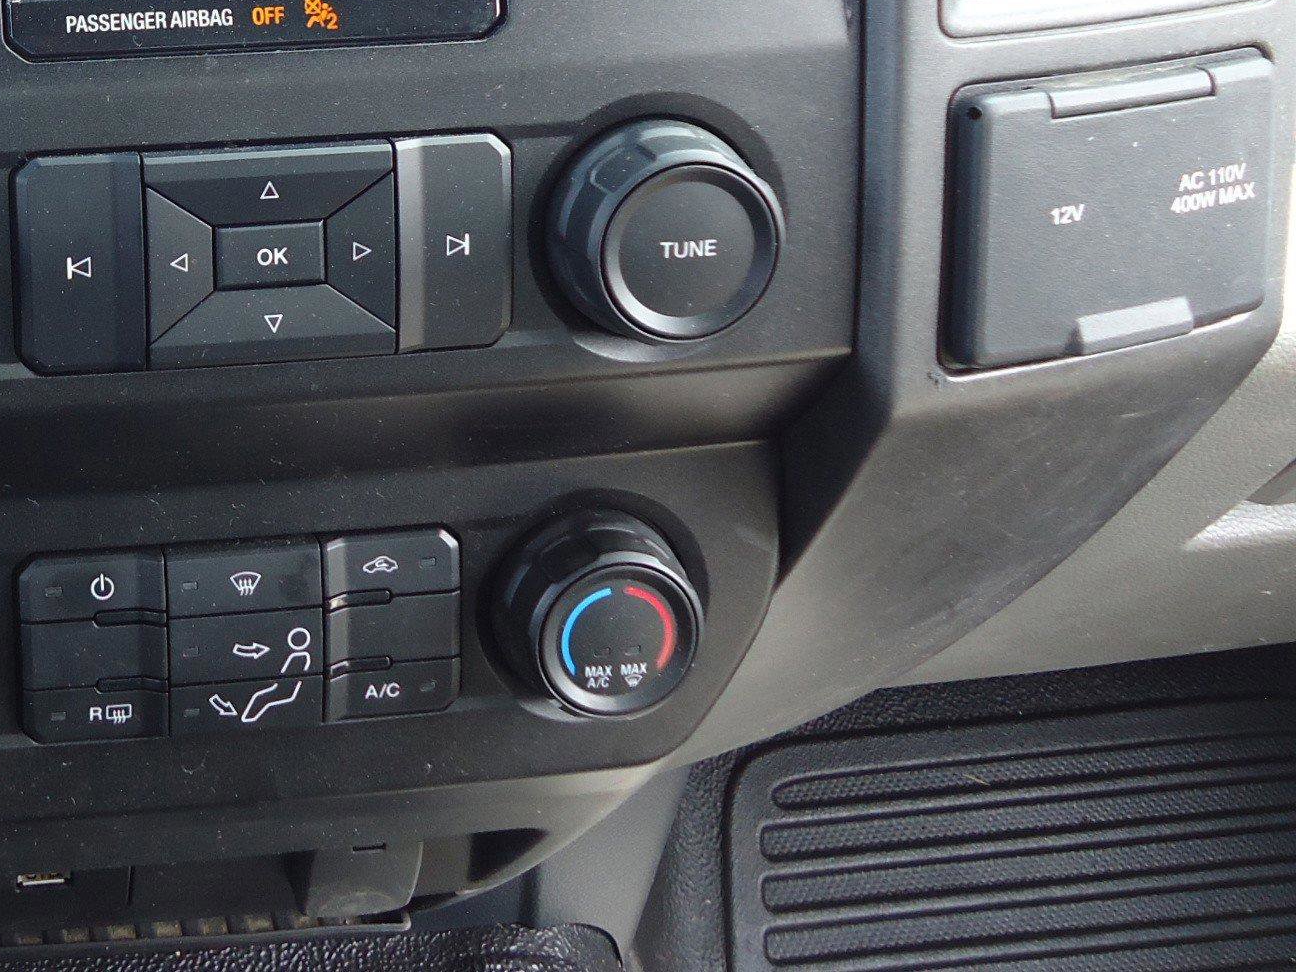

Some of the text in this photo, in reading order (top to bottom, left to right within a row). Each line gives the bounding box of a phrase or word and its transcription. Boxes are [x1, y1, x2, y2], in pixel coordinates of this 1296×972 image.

[65, 6, 285, 34] PASSENGER AIRBAG OFF
[1178, 163, 1247, 192] AC 110V
[1170, 182, 1256, 214] 400W MAX
[1050, 203, 1085, 226] 12V
[256, 247, 288, 266] OK
[659, 238, 718, 259] TUNE
[584, 665, 613, 677] MAX
[620, 662, 648, 675] MAX
[365, 681, 401, 699] A/C
[587, 677, 610, 689] A/C
[89, 706, 103, 722] R
